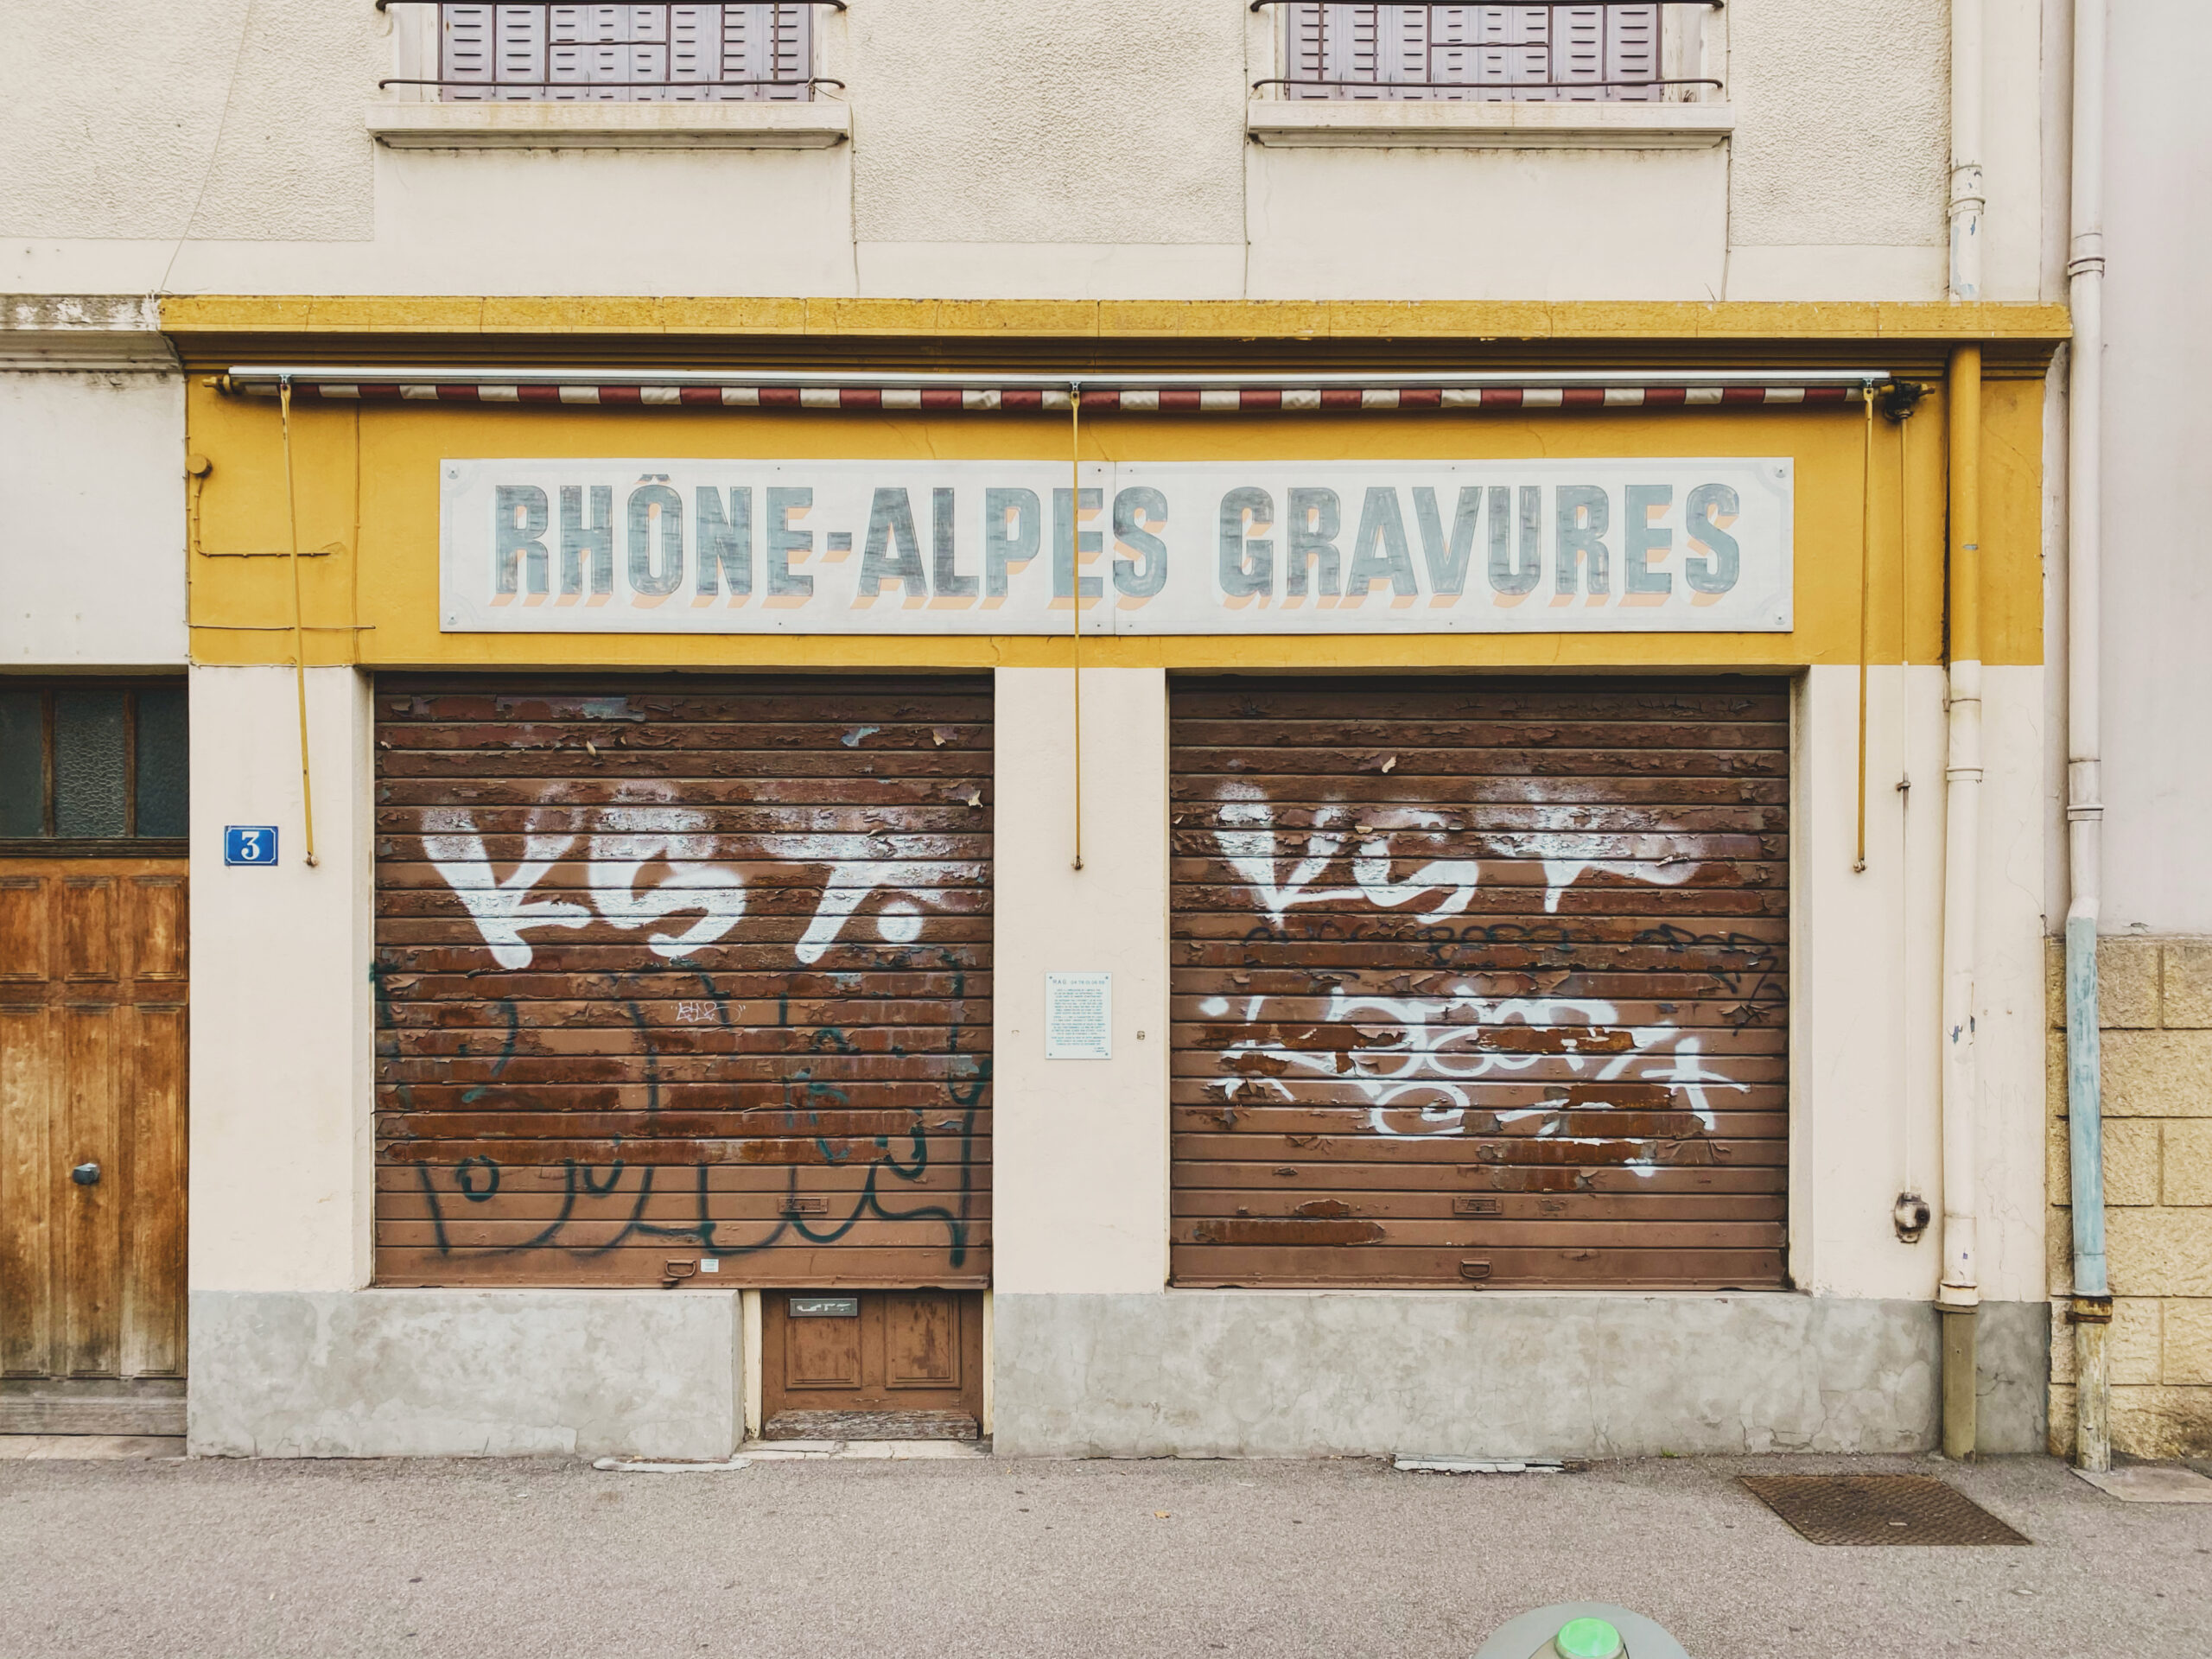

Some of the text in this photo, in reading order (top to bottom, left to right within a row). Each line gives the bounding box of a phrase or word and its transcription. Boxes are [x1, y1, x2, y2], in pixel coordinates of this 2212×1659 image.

[491, 473, 1742, 608] RHÔNE-ALPES GRAVURES
[240, 830, 260, 861] 3
